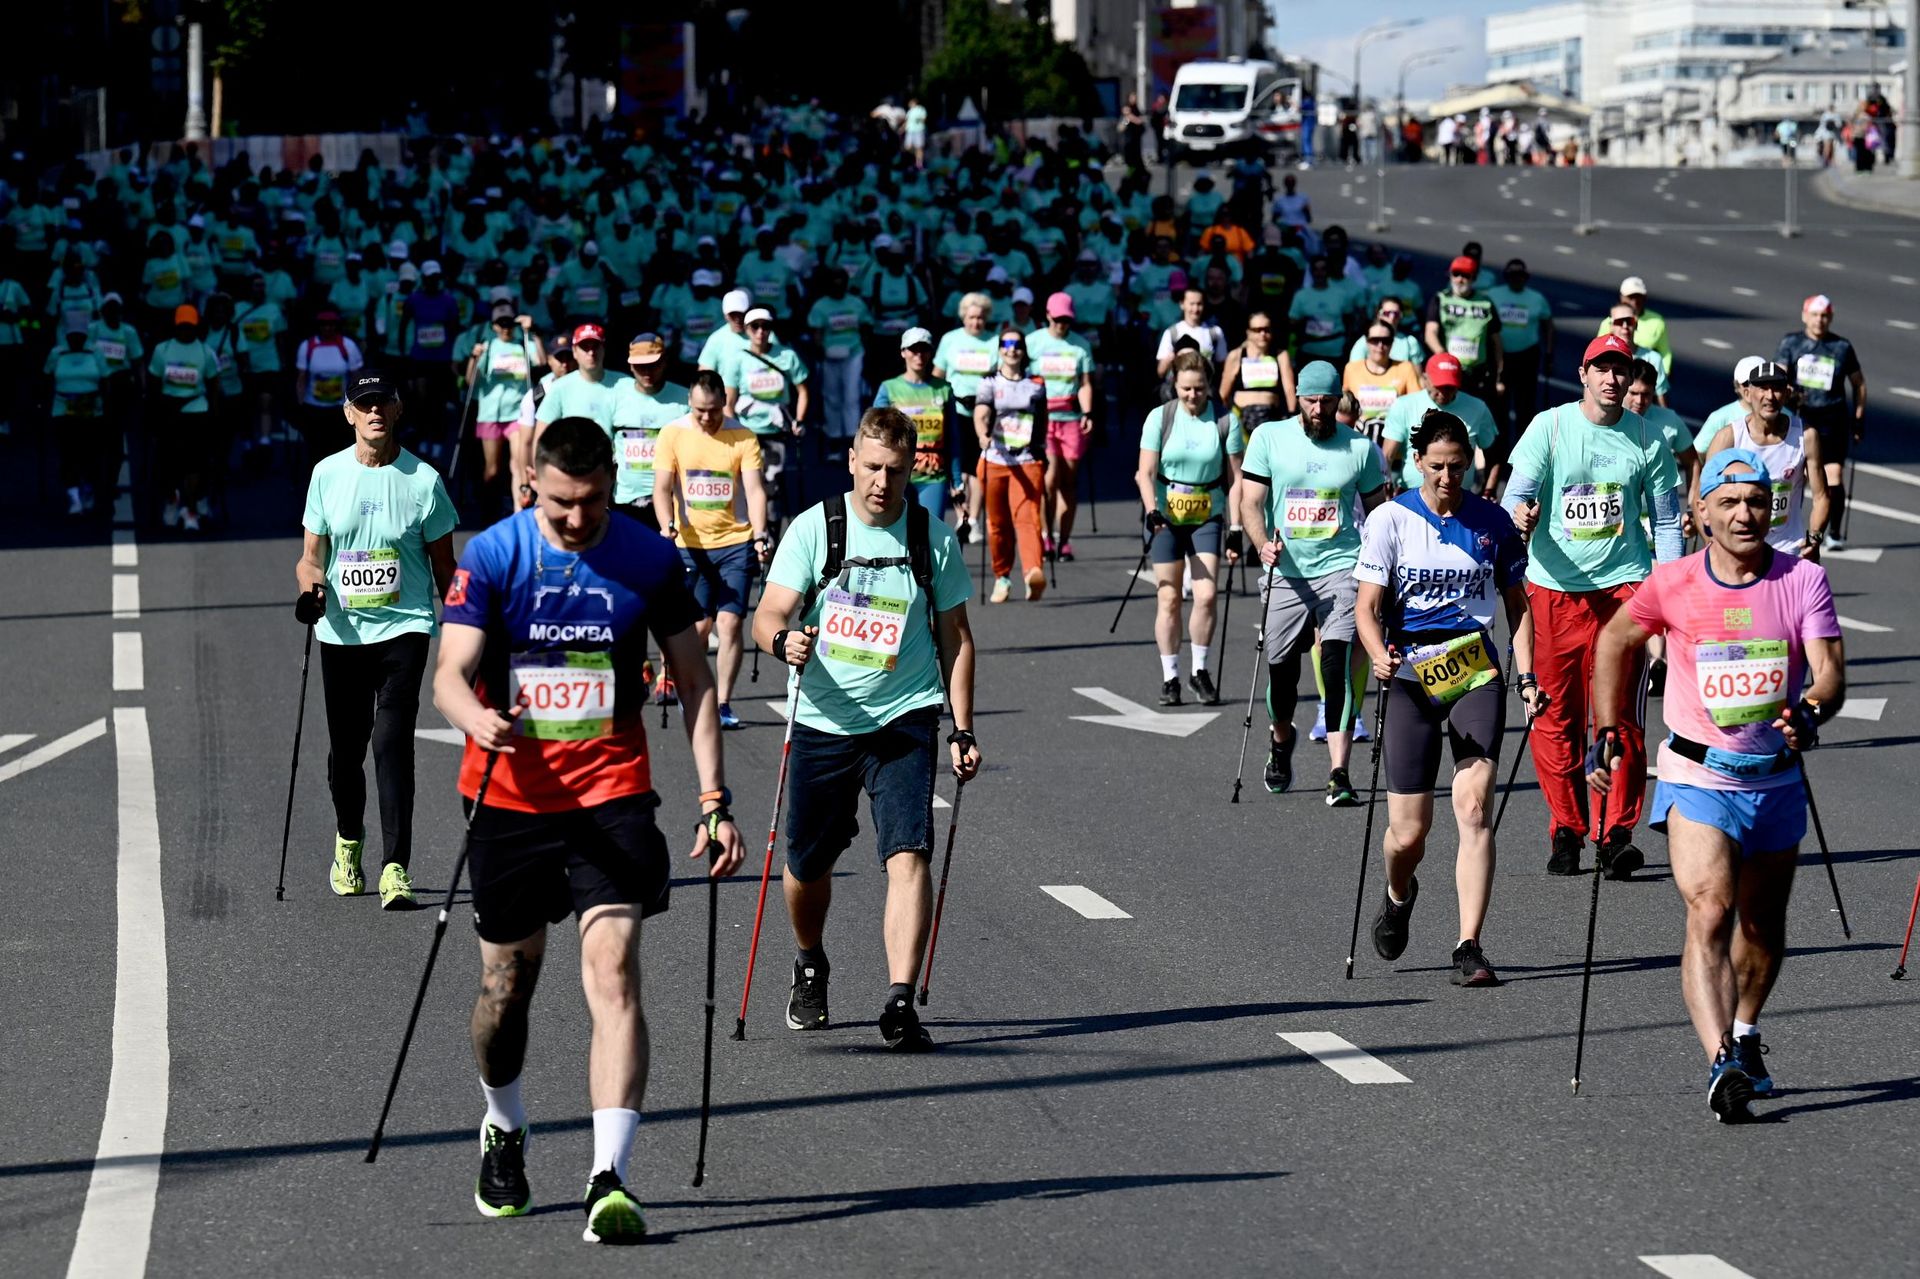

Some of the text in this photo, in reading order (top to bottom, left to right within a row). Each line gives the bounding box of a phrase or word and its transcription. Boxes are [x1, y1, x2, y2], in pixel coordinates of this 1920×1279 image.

[687, 483, 730, 496] 60358
[1168, 498, 1208, 512] 60079
[1287, 506, 1337, 522] 60582
[1566, 499, 1620, 520] 60195
[341, 566, 398, 587] 60029
[1397, 565, 1493, 583] СЕВЕРНАЯ
[355, 586, 385, 594] НИКОЛАЙ
[529, 623, 614, 643] МОСКВА
[826, 613, 898, 646] 60493
[1423, 645, 1480, 687] 60019
[1450, 671, 1469, 686] ЮЛИЯ
[1703, 669, 1784, 698] 60329
[516, 681, 606, 709] 60371
